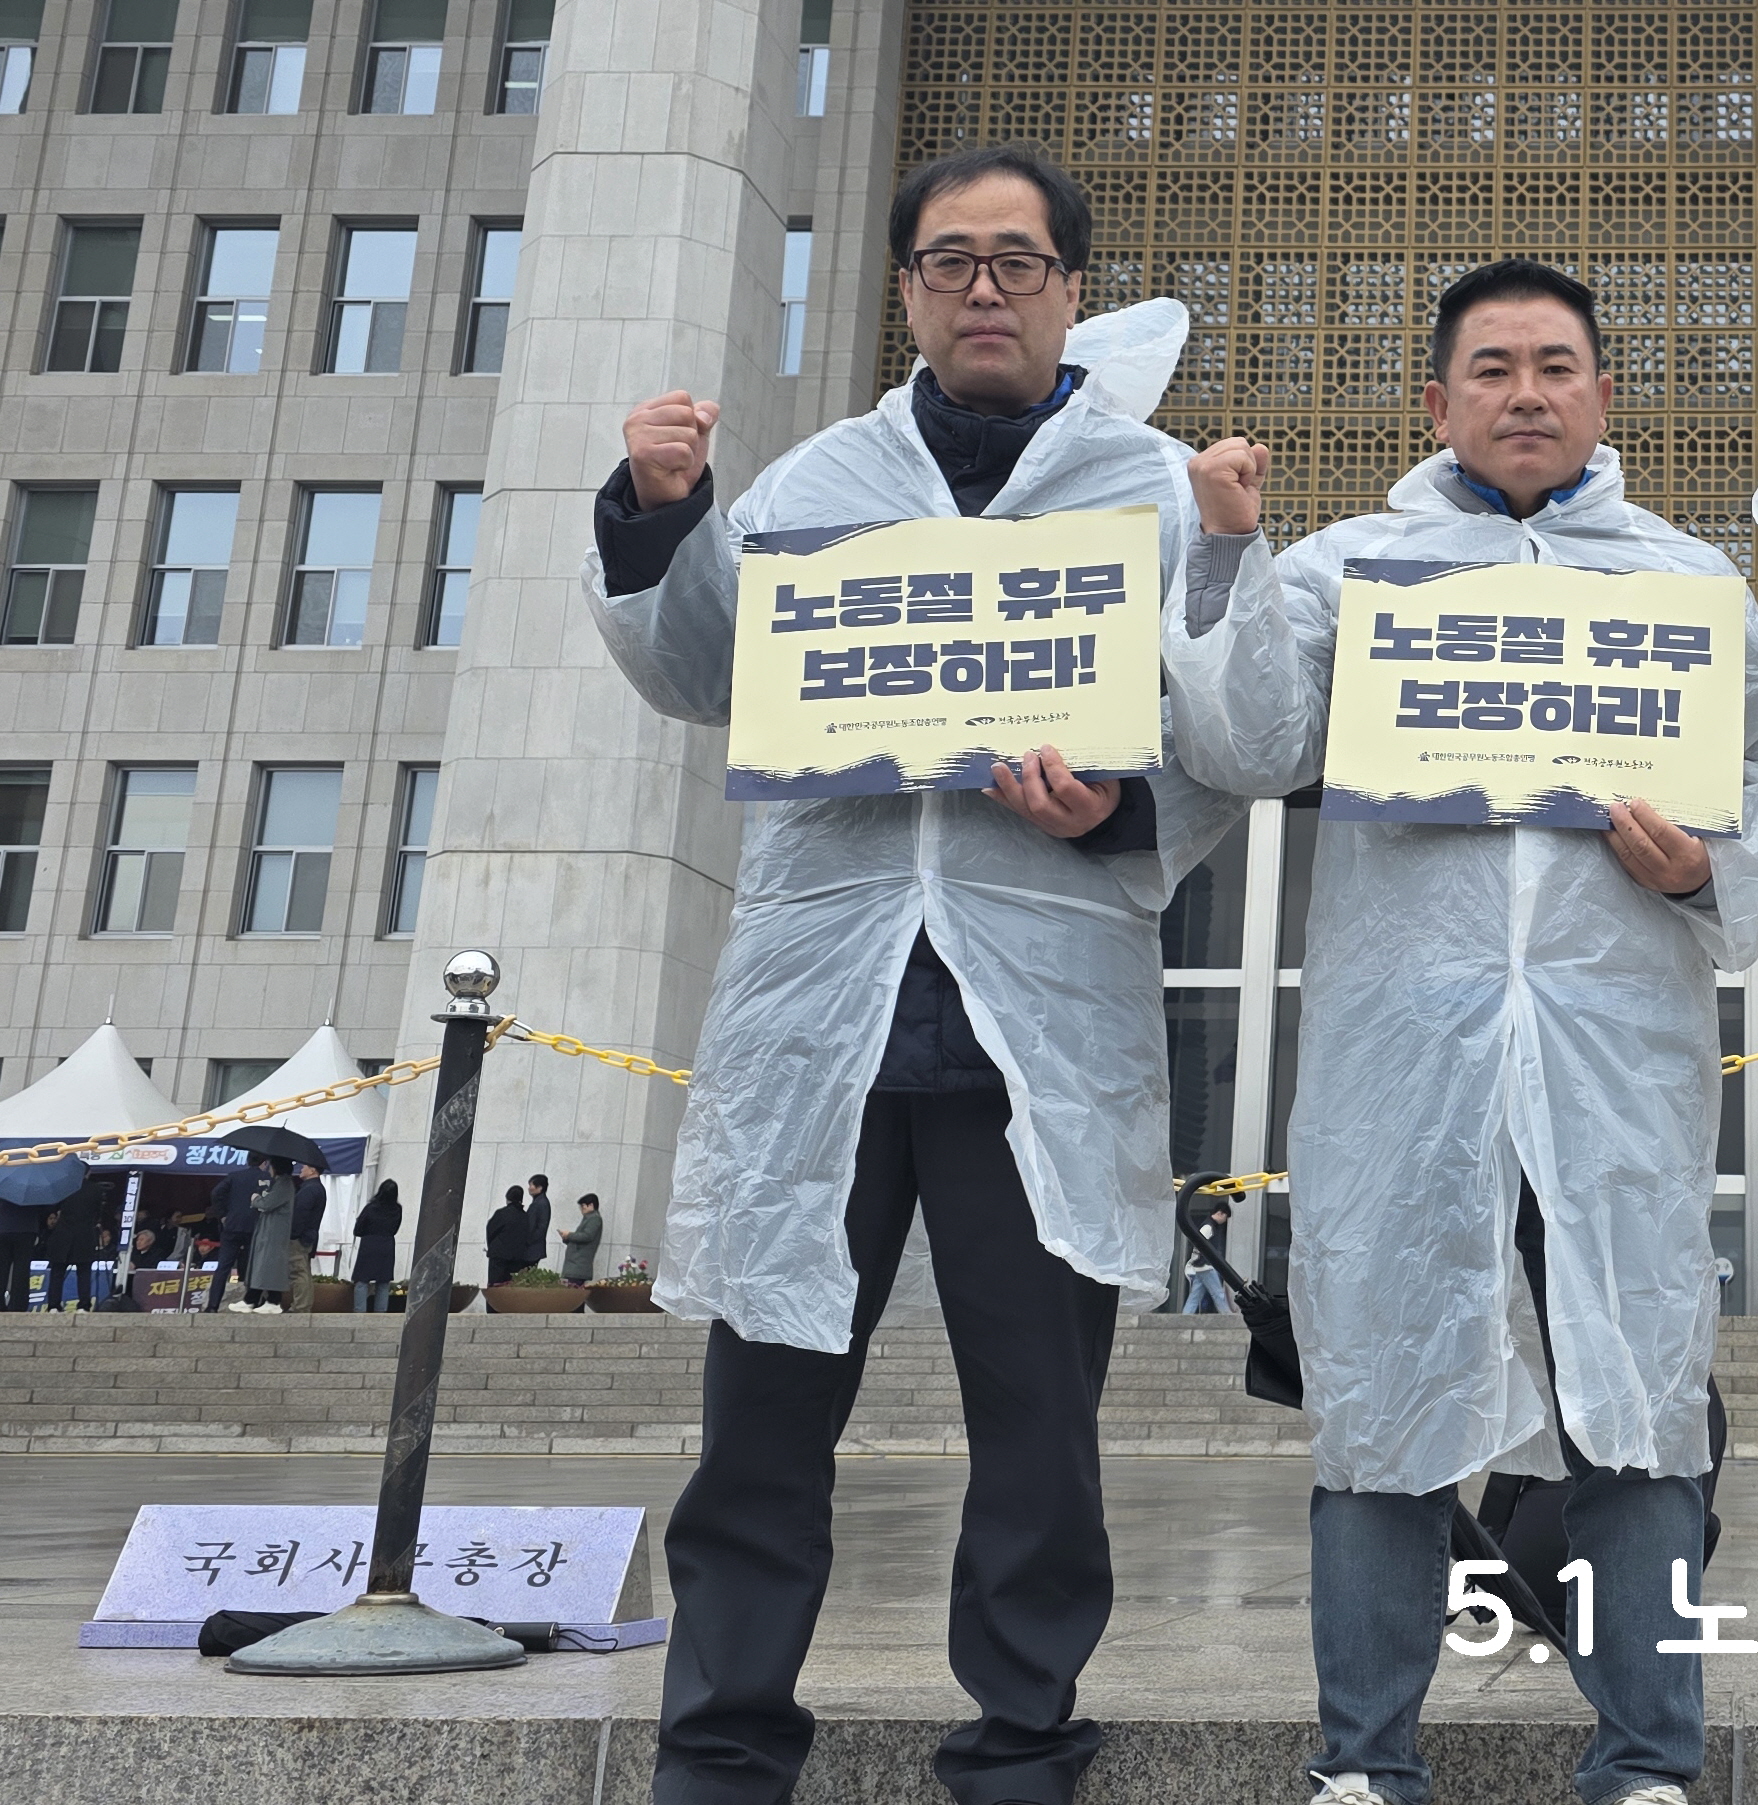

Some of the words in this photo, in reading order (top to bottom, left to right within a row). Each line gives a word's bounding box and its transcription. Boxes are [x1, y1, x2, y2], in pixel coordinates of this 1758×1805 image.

[771, 572, 973, 633] 노동절
[998, 563, 1126, 621] 휴무
[800, 634, 1096, 701] 보장하라!
[1369, 612, 1565, 665] 노동절
[1587, 619, 1712, 672] 휴무
[1395, 679, 1682, 738] 보장하라!
[147, 1279, 181, 1296] 지금
